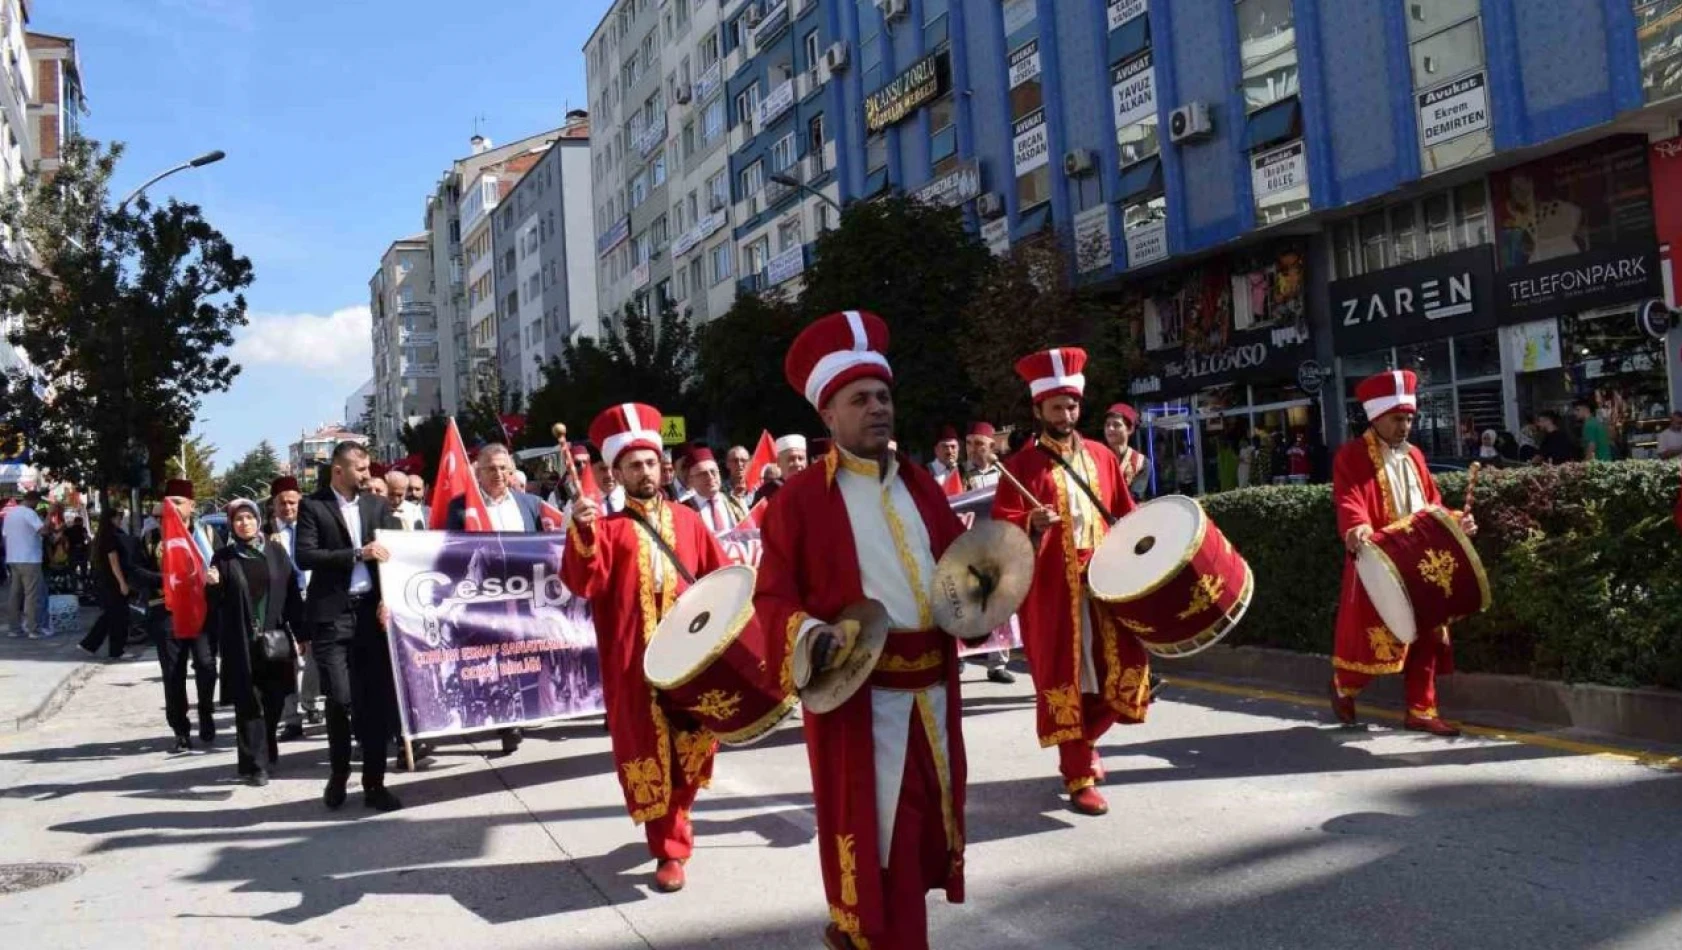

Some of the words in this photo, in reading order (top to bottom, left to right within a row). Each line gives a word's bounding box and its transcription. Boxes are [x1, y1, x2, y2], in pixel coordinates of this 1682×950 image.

[904, 56, 936, 93] ZORLU
[1116, 56, 1150, 81] AVUKAT
[1118, 77, 1151, 100] YAVUZ
[1424, 78, 1478, 104] Avukat
[1119, 91, 1152, 114] ALKAN
[1434, 102, 1469, 120] Ekrem
[1015, 112, 1042, 134] AVUKAT
[1017, 131, 1043, 151] ERCAN
[1508, 255, 1647, 301] TELEFONPARK
[1341, 272, 1473, 327] ZAREN
